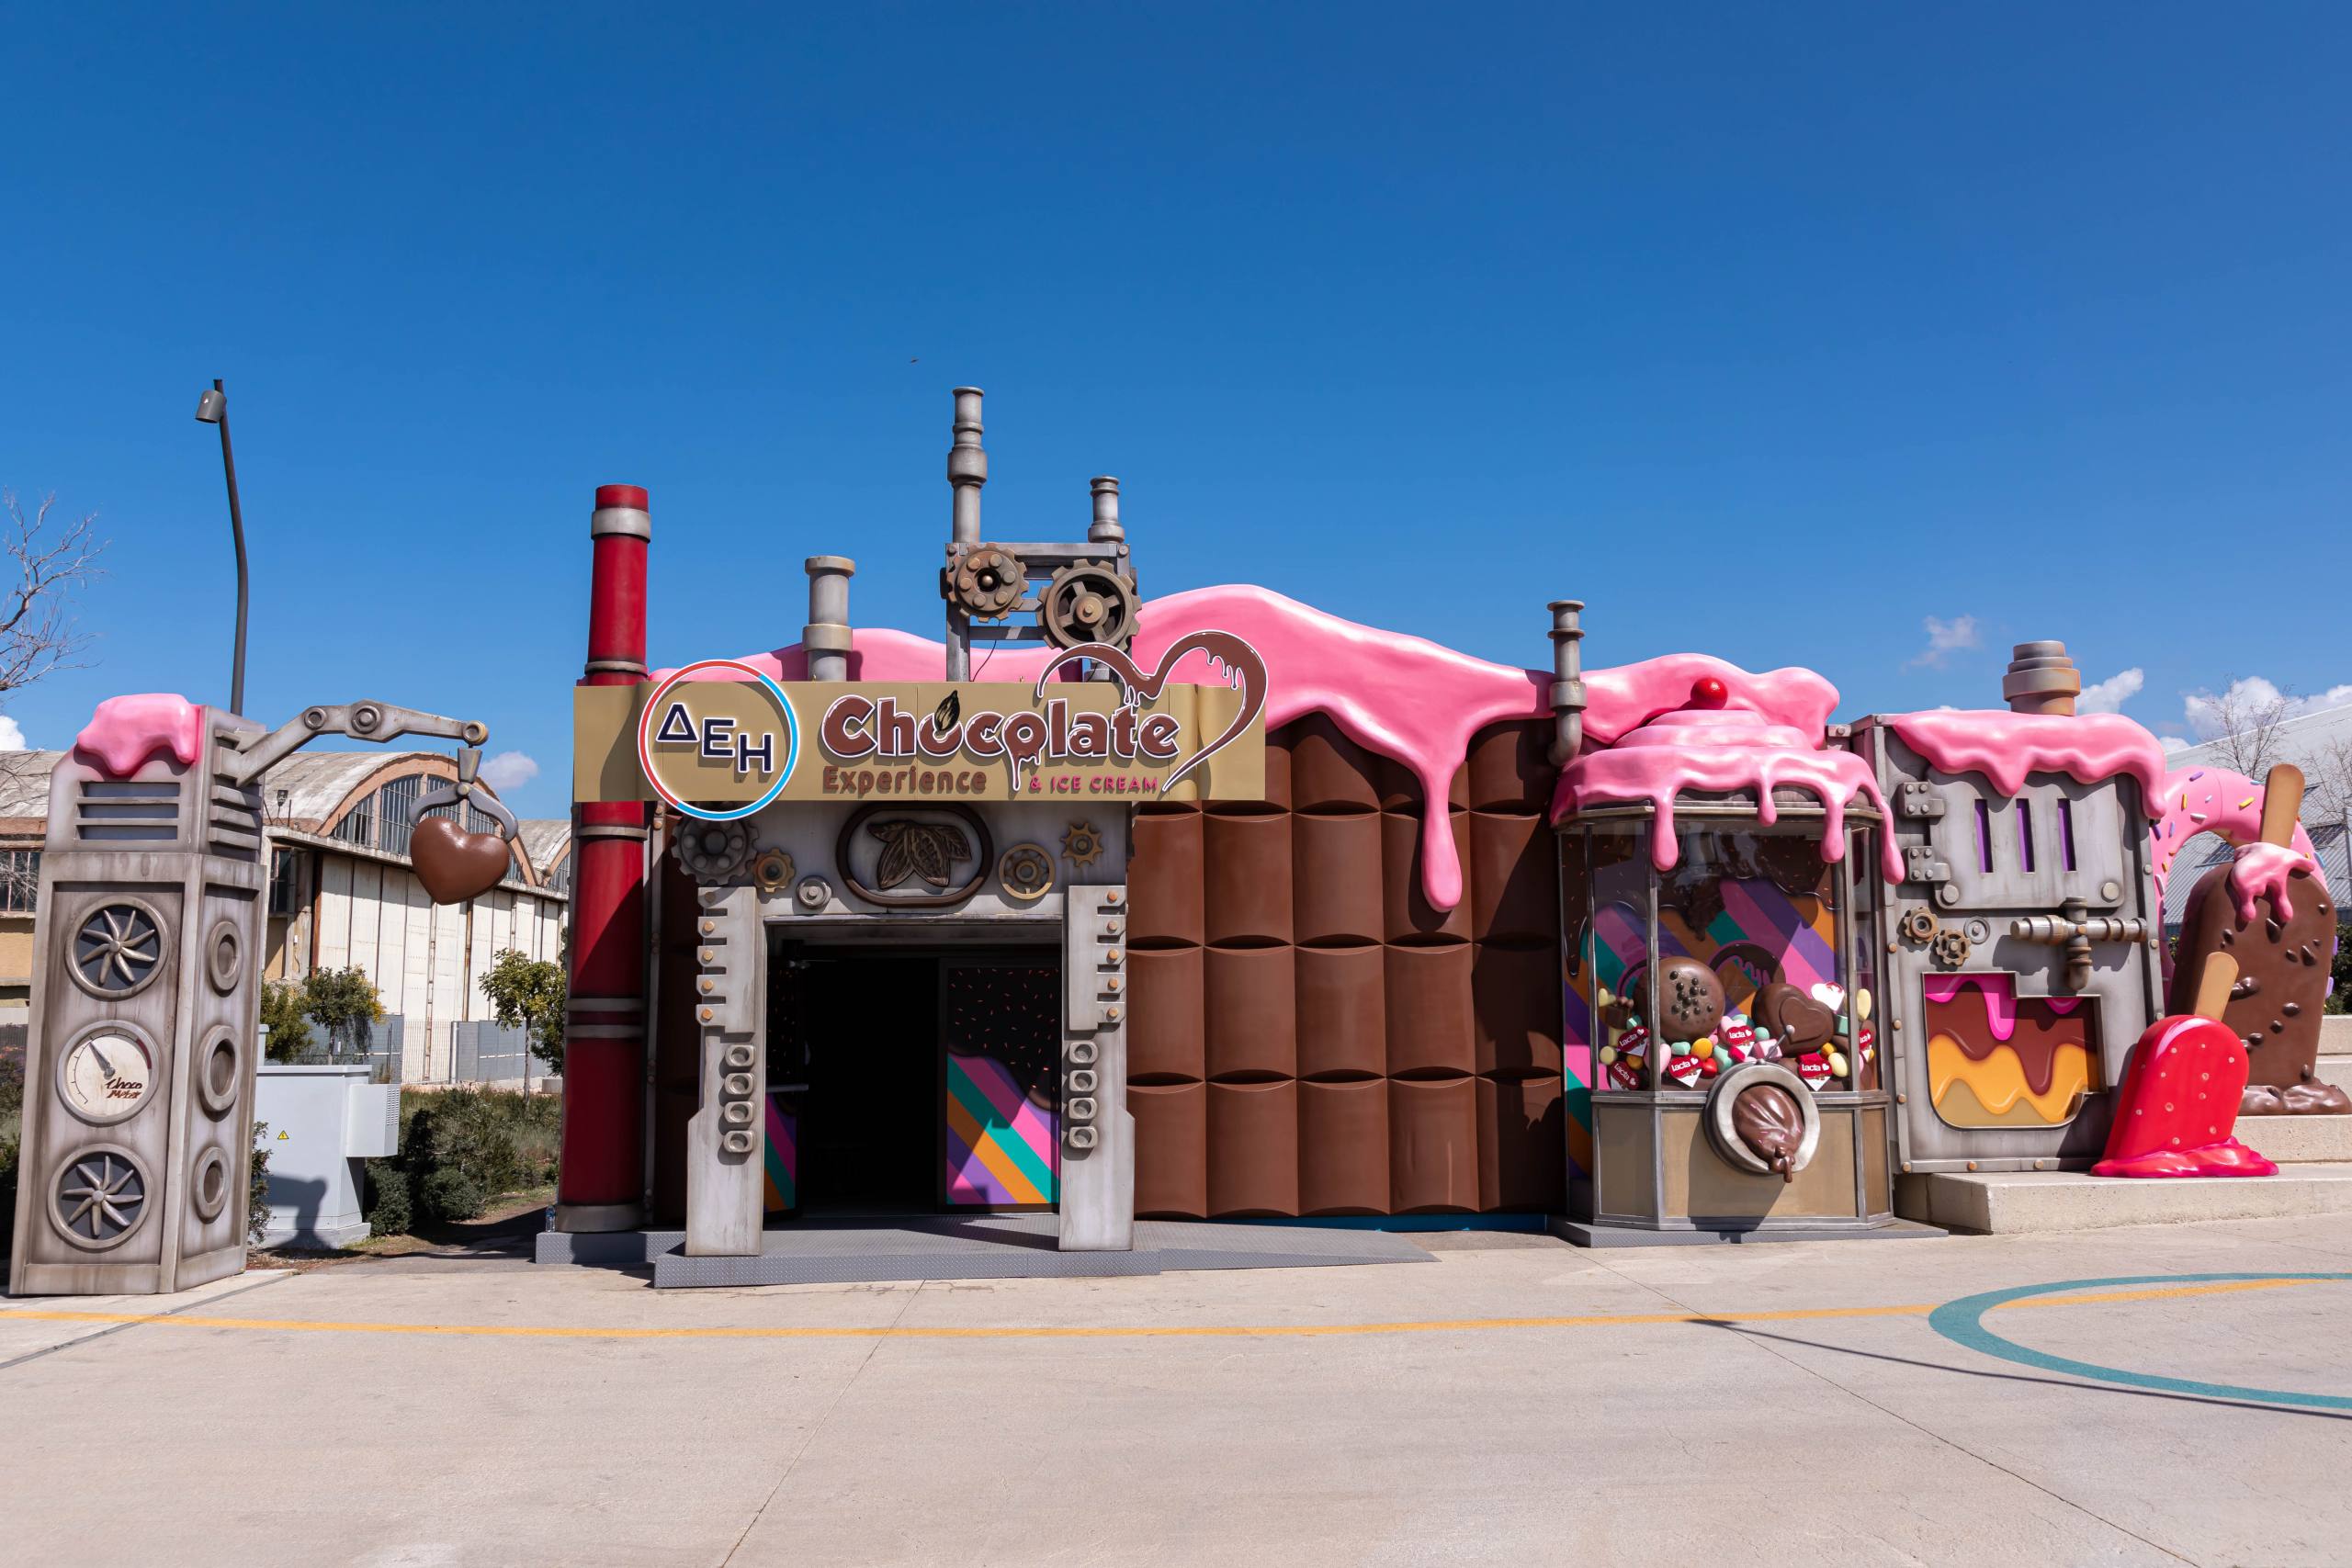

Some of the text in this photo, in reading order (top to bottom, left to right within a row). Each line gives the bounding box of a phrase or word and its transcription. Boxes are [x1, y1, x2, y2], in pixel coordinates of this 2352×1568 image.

[656, 703, 774, 773] ΔΕΗ
[821, 693, 1181, 791] Chocolate
[823, 765, 987, 795] Experience
[1030, 775, 1158, 790] & ICE CREAM
